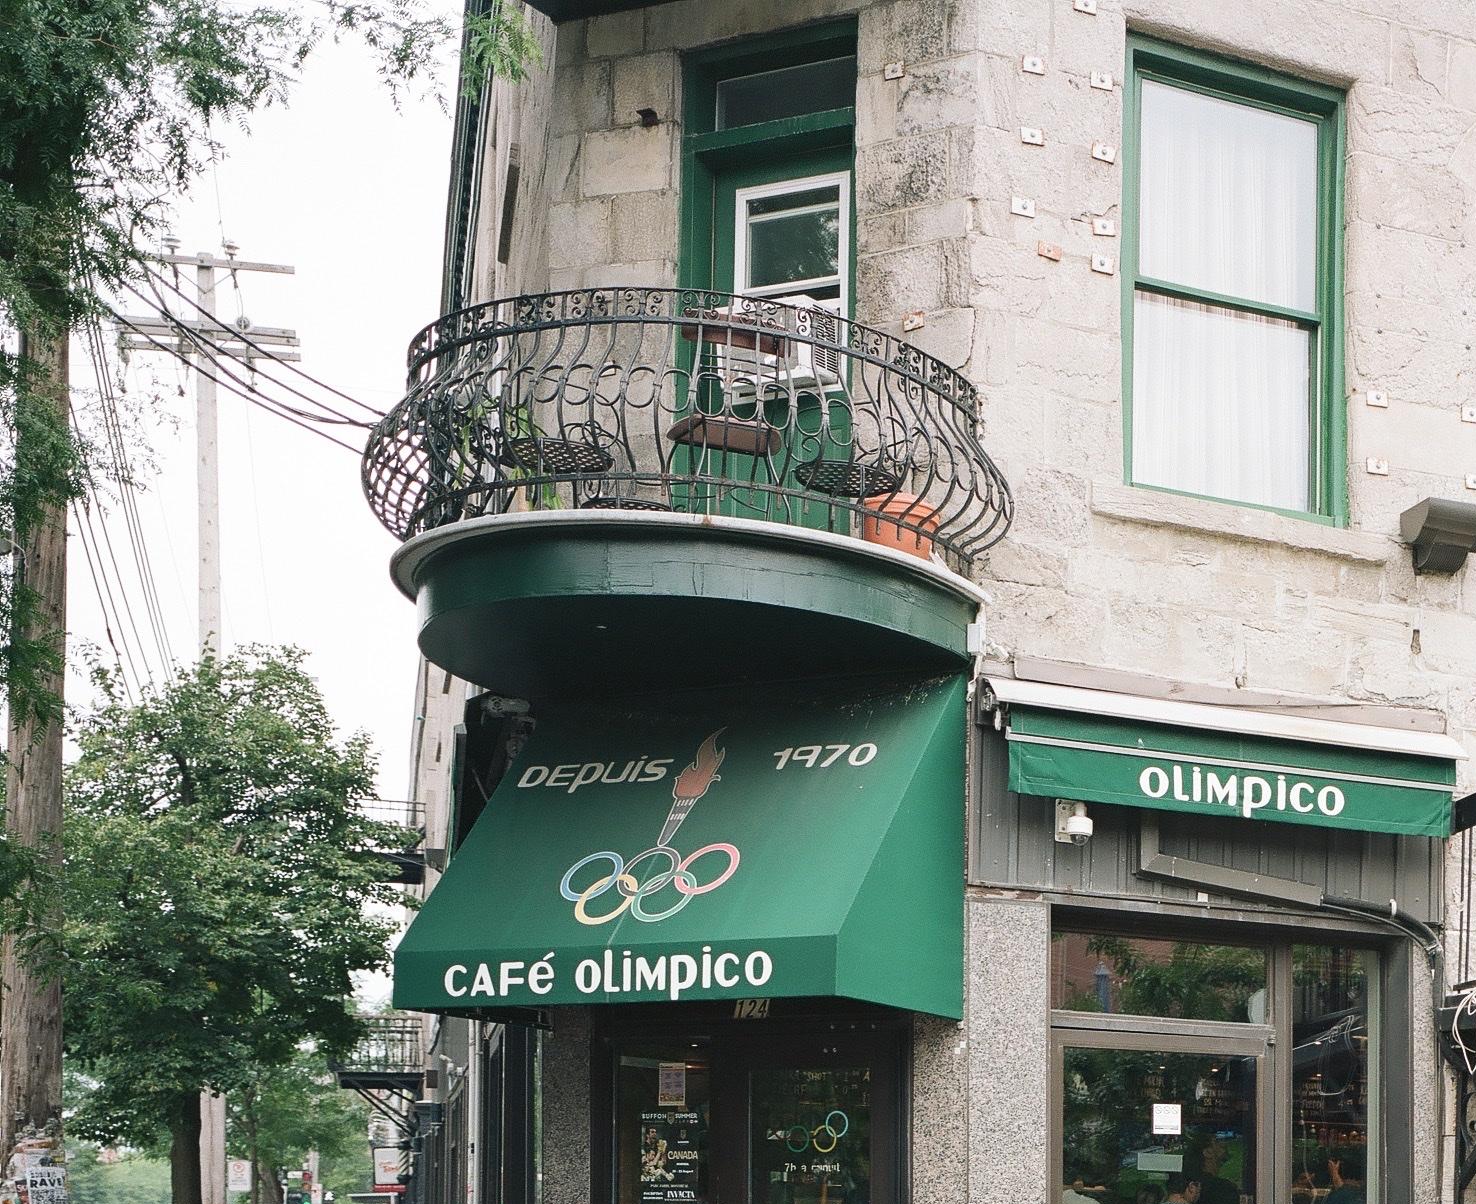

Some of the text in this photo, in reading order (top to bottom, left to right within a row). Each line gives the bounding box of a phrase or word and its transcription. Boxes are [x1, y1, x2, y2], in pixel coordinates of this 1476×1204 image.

[773, 743, 878, 770] 1970
[737, 999, 768, 1019] 124
[667, 1150, 699, 1160] CANADA
